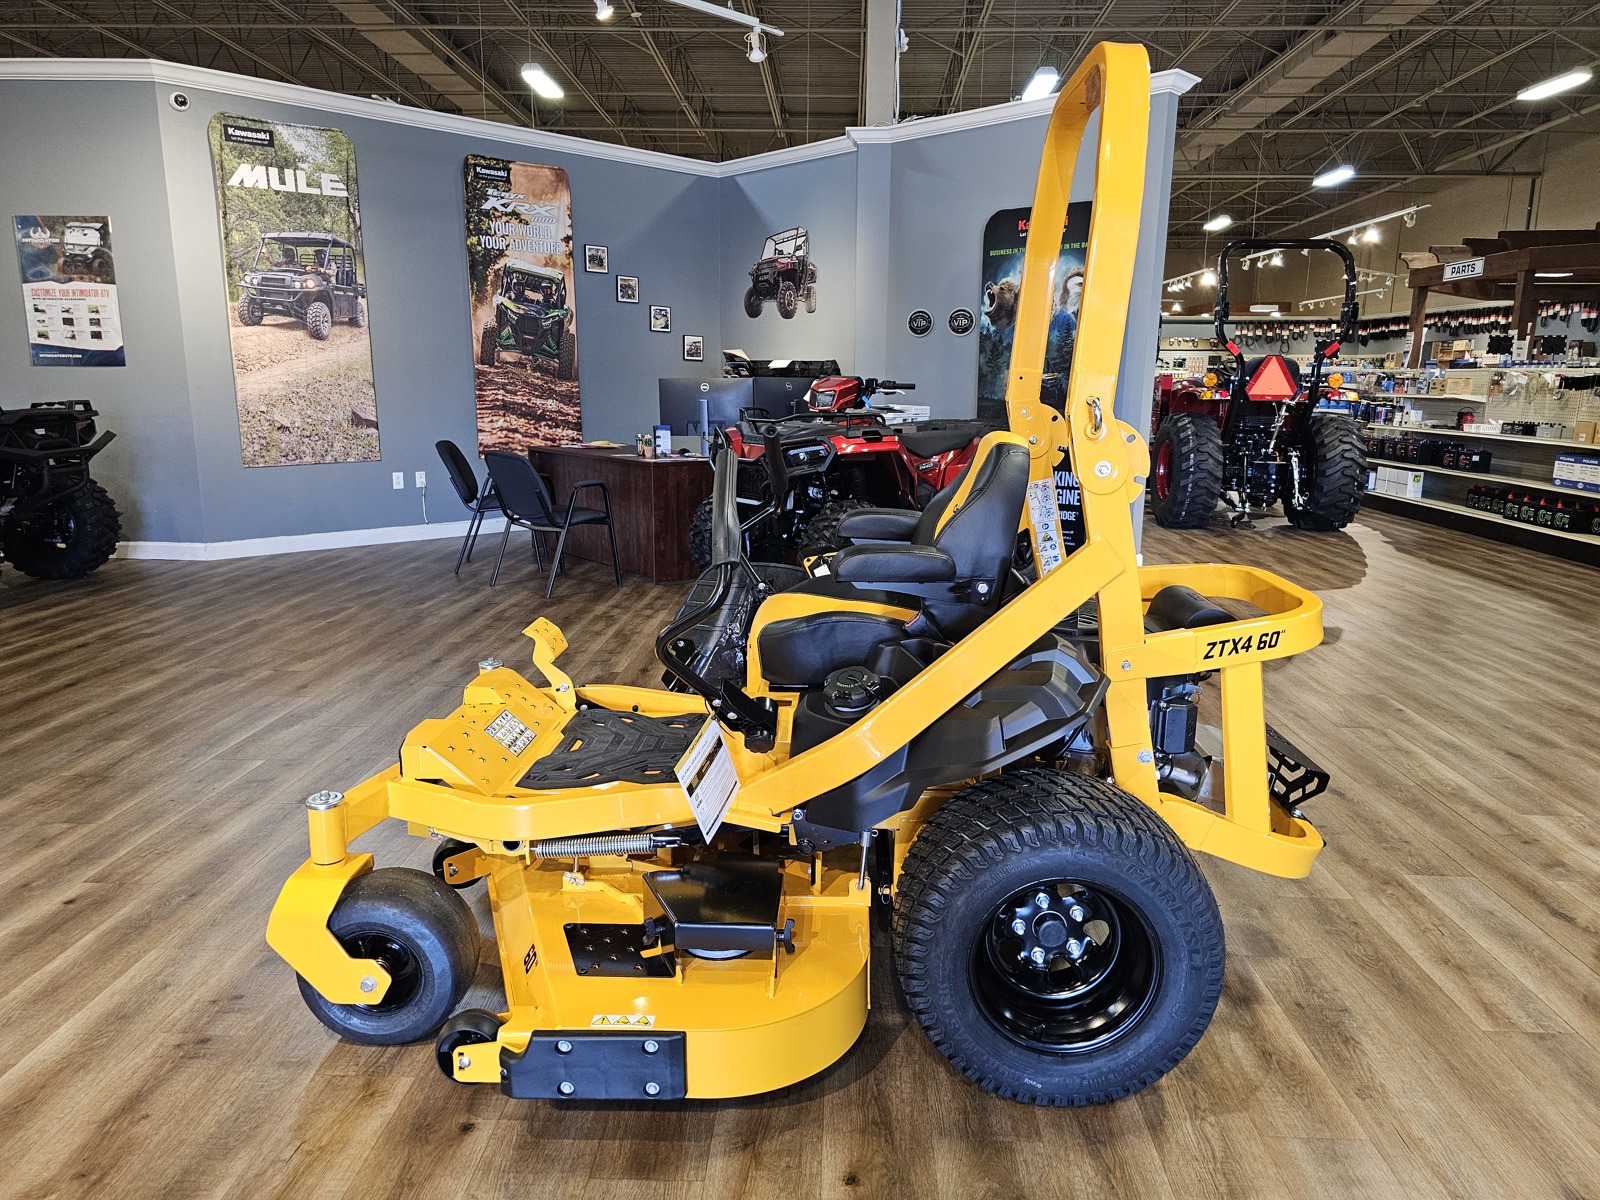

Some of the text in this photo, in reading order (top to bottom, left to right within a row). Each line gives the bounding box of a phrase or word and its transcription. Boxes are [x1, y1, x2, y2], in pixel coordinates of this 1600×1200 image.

[227, 127, 270, 140] Kawasaki
[476, 166, 507, 177] Kawasaki
[226, 163, 349, 197] MULE
[480, 196, 556, 217] KRX
[531, 216, 557, 224] 1000
[489, 221, 554, 239] YOUR WORLD.
[480, 235, 562, 254] YOUR ADVENTURE.
[990, 248, 1012, 256] BUSINESS
[1451, 263, 1476, 276] PARTS
[31, 288, 110, 298] CUSTOMIZE YOUR INTIMIDATOR UTV
[1202, 635, 1253, 660] ZTX4
